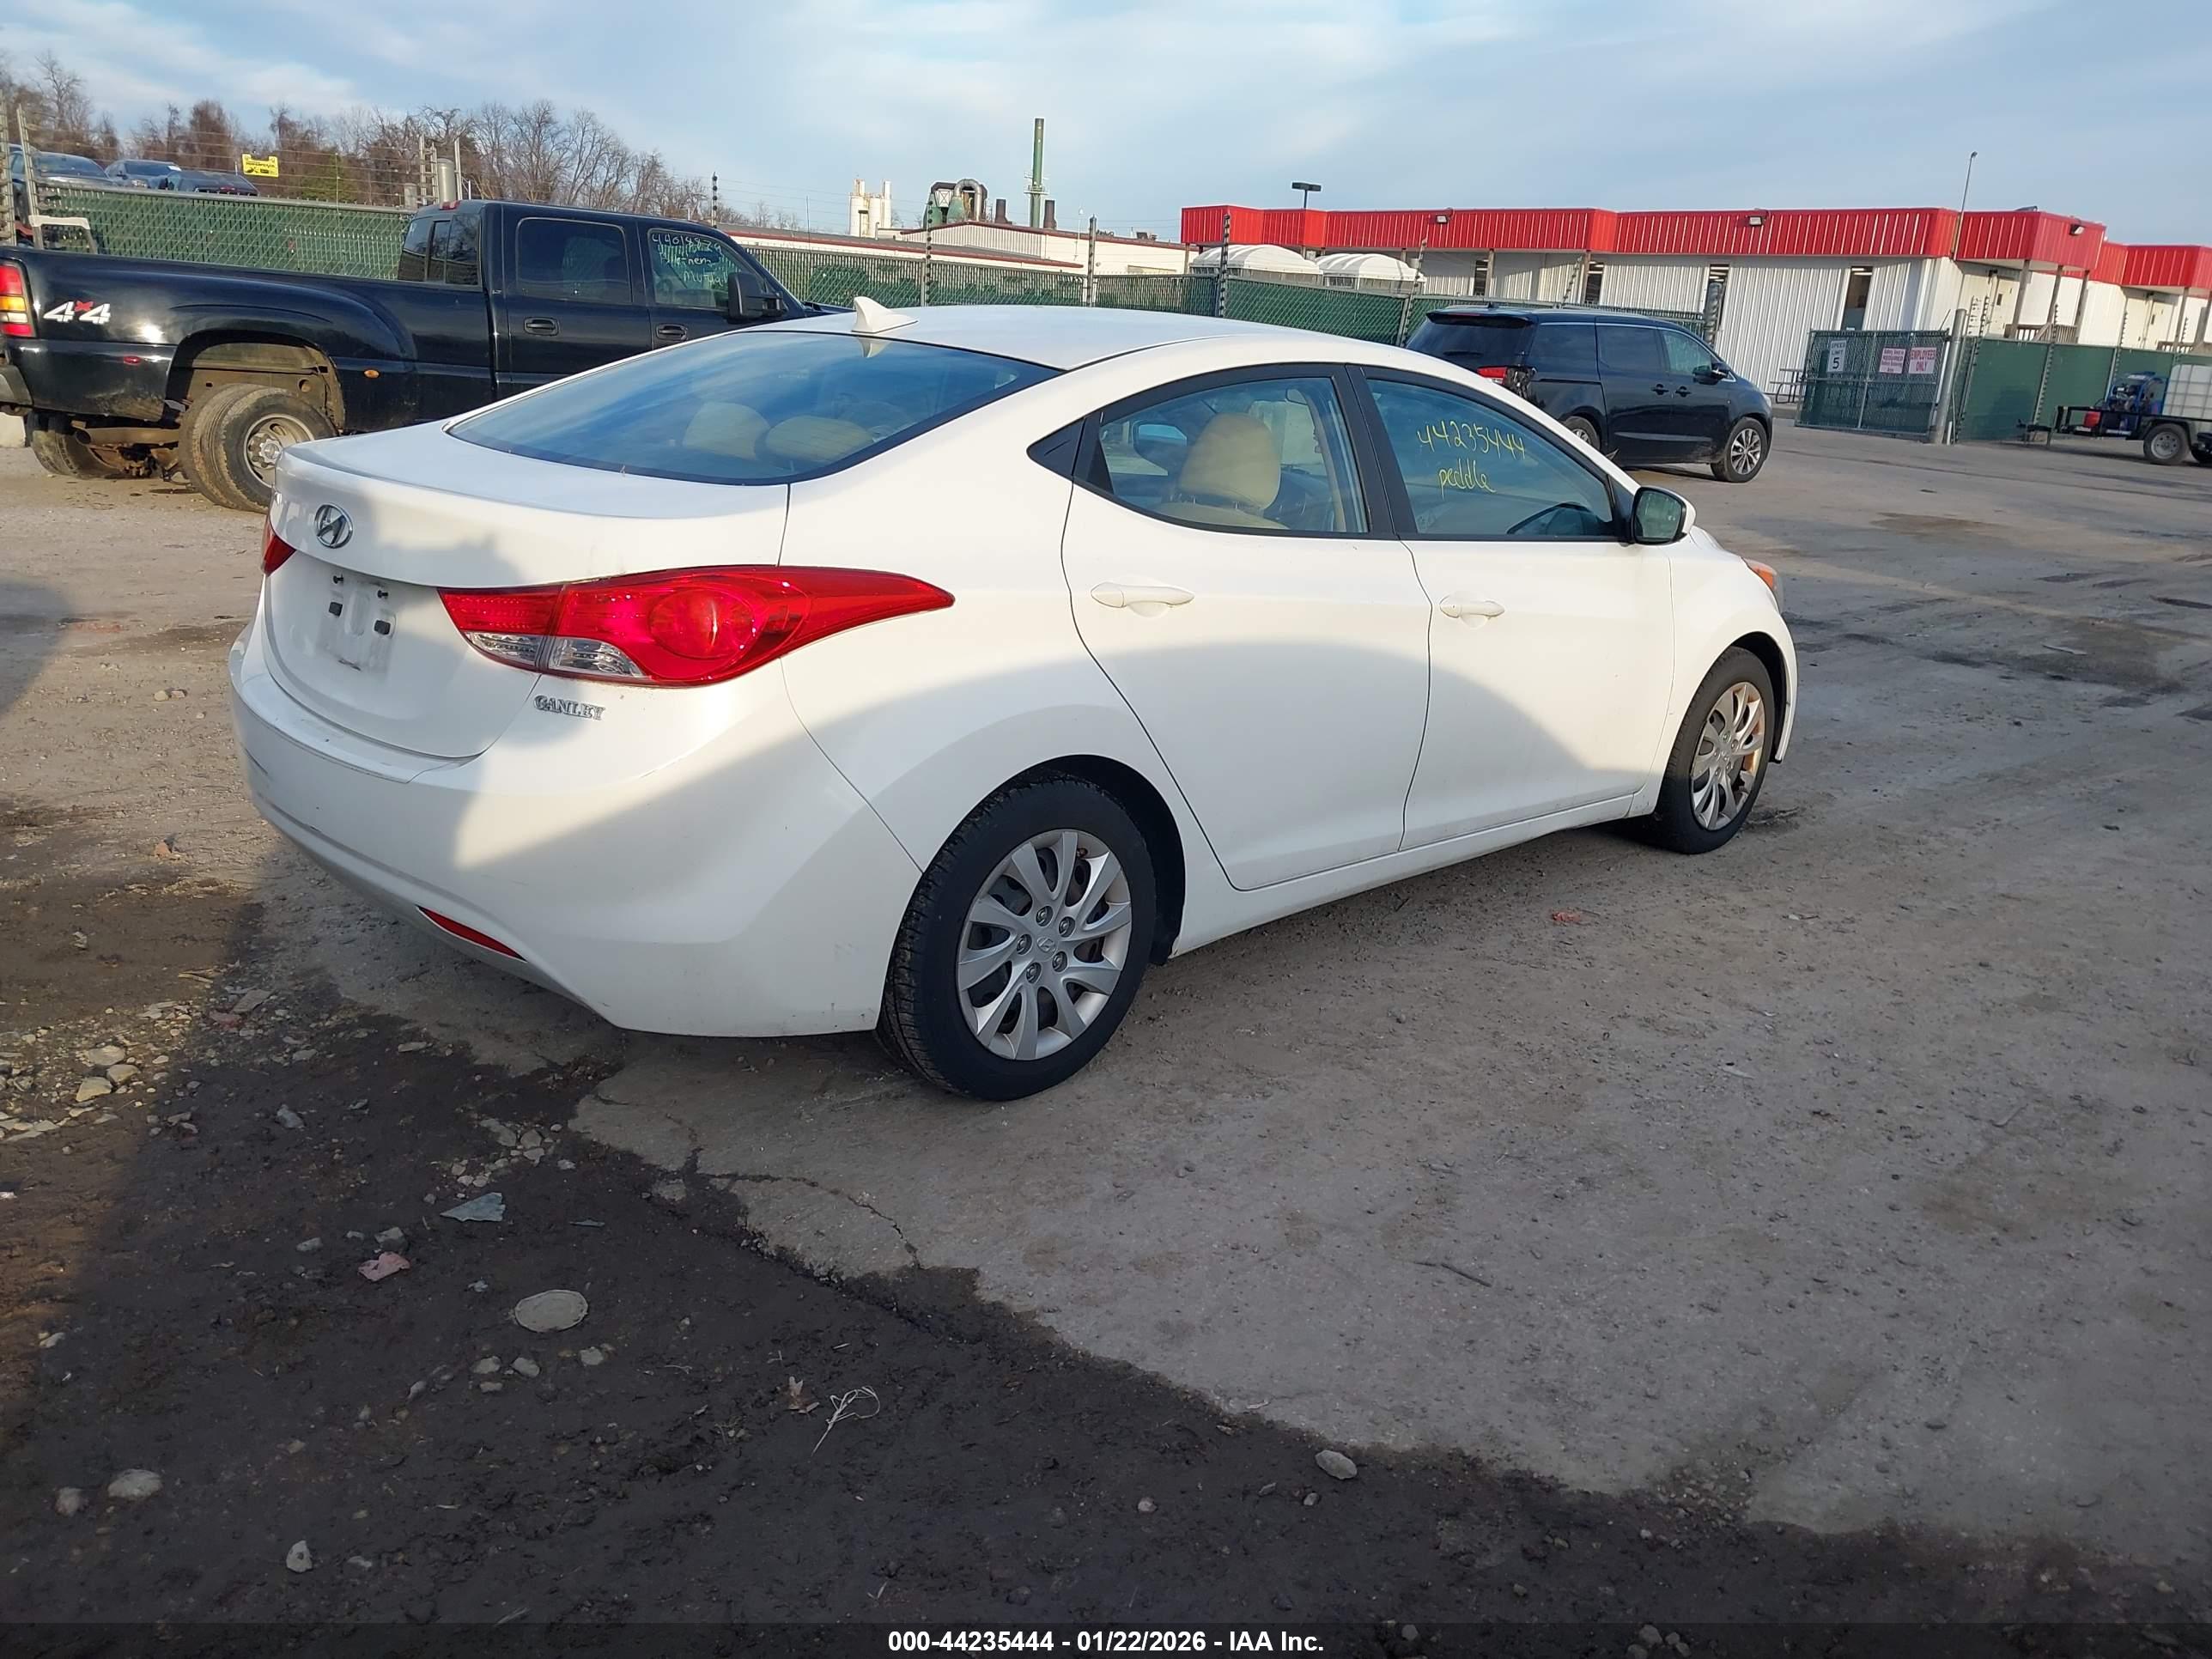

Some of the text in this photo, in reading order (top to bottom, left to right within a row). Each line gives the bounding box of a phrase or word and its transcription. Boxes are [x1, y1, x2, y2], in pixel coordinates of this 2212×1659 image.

[1911, 349, 1936, 360] EMPLOYEES
[1832, 356, 1840, 369] 5
[1916, 361, 1928, 372] ONLY
[1417, 421, 1526, 459] 44235444
[534, 695, 606, 720] GANLEY
